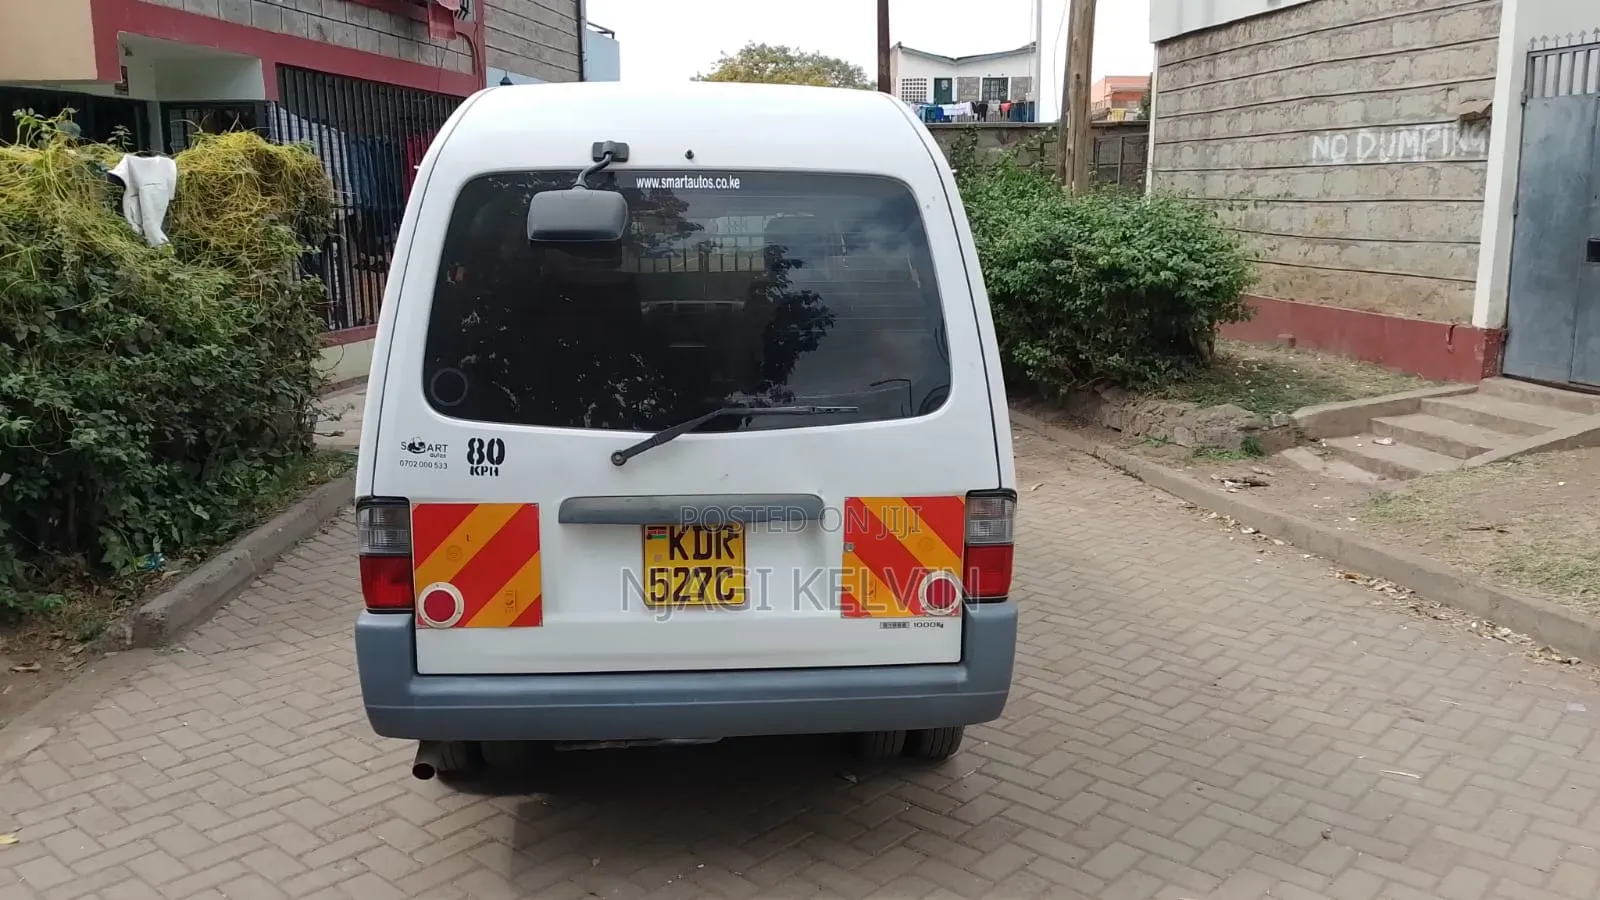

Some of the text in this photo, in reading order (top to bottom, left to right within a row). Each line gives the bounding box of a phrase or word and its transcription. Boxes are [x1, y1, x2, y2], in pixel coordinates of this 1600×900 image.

[1312, 133, 1348, 164] NO
[636, 174, 740, 189] www.smartautos.co.ke
[467, 437, 505, 466] 80
[470, 466, 499, 477] KPH
[669, 526, 737, 560] KDR
[650, 567, 735, 602] 527C
